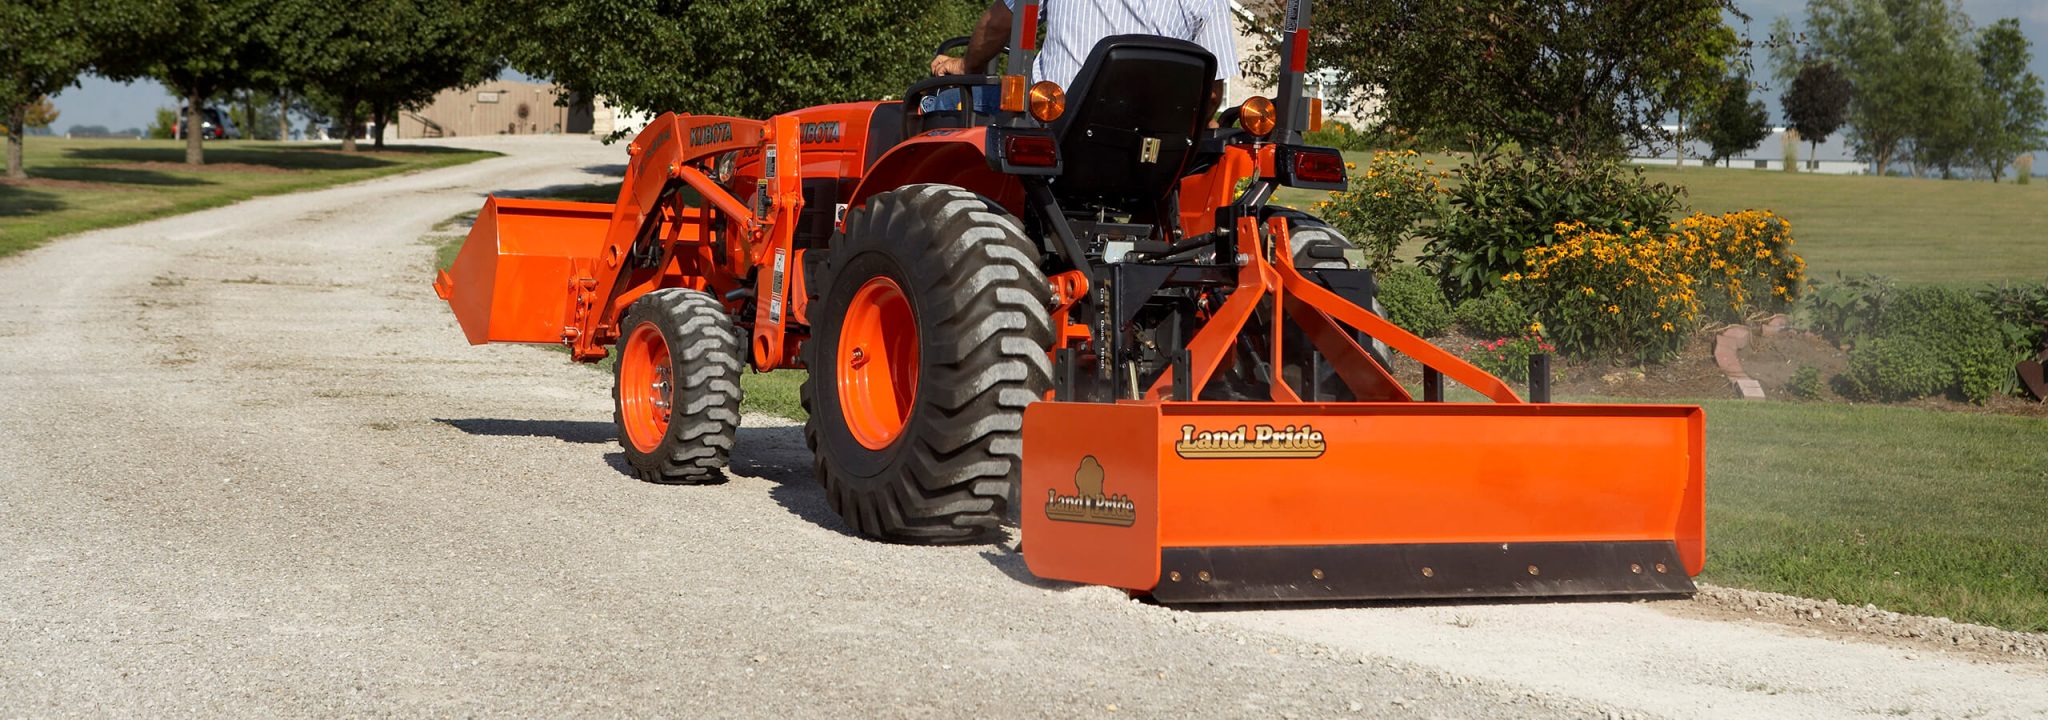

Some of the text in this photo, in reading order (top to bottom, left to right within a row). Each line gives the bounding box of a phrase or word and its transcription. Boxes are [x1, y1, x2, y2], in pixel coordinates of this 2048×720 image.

[690, 122, 733, 146] KUBOTA
[800, 121, 840, 144] UBOTA
[1103, 278, 1113, 380] Land Pride
[1180, 424, 1324, 450] Land Pride
[1047, 488, 1135, 518] Land Pride
